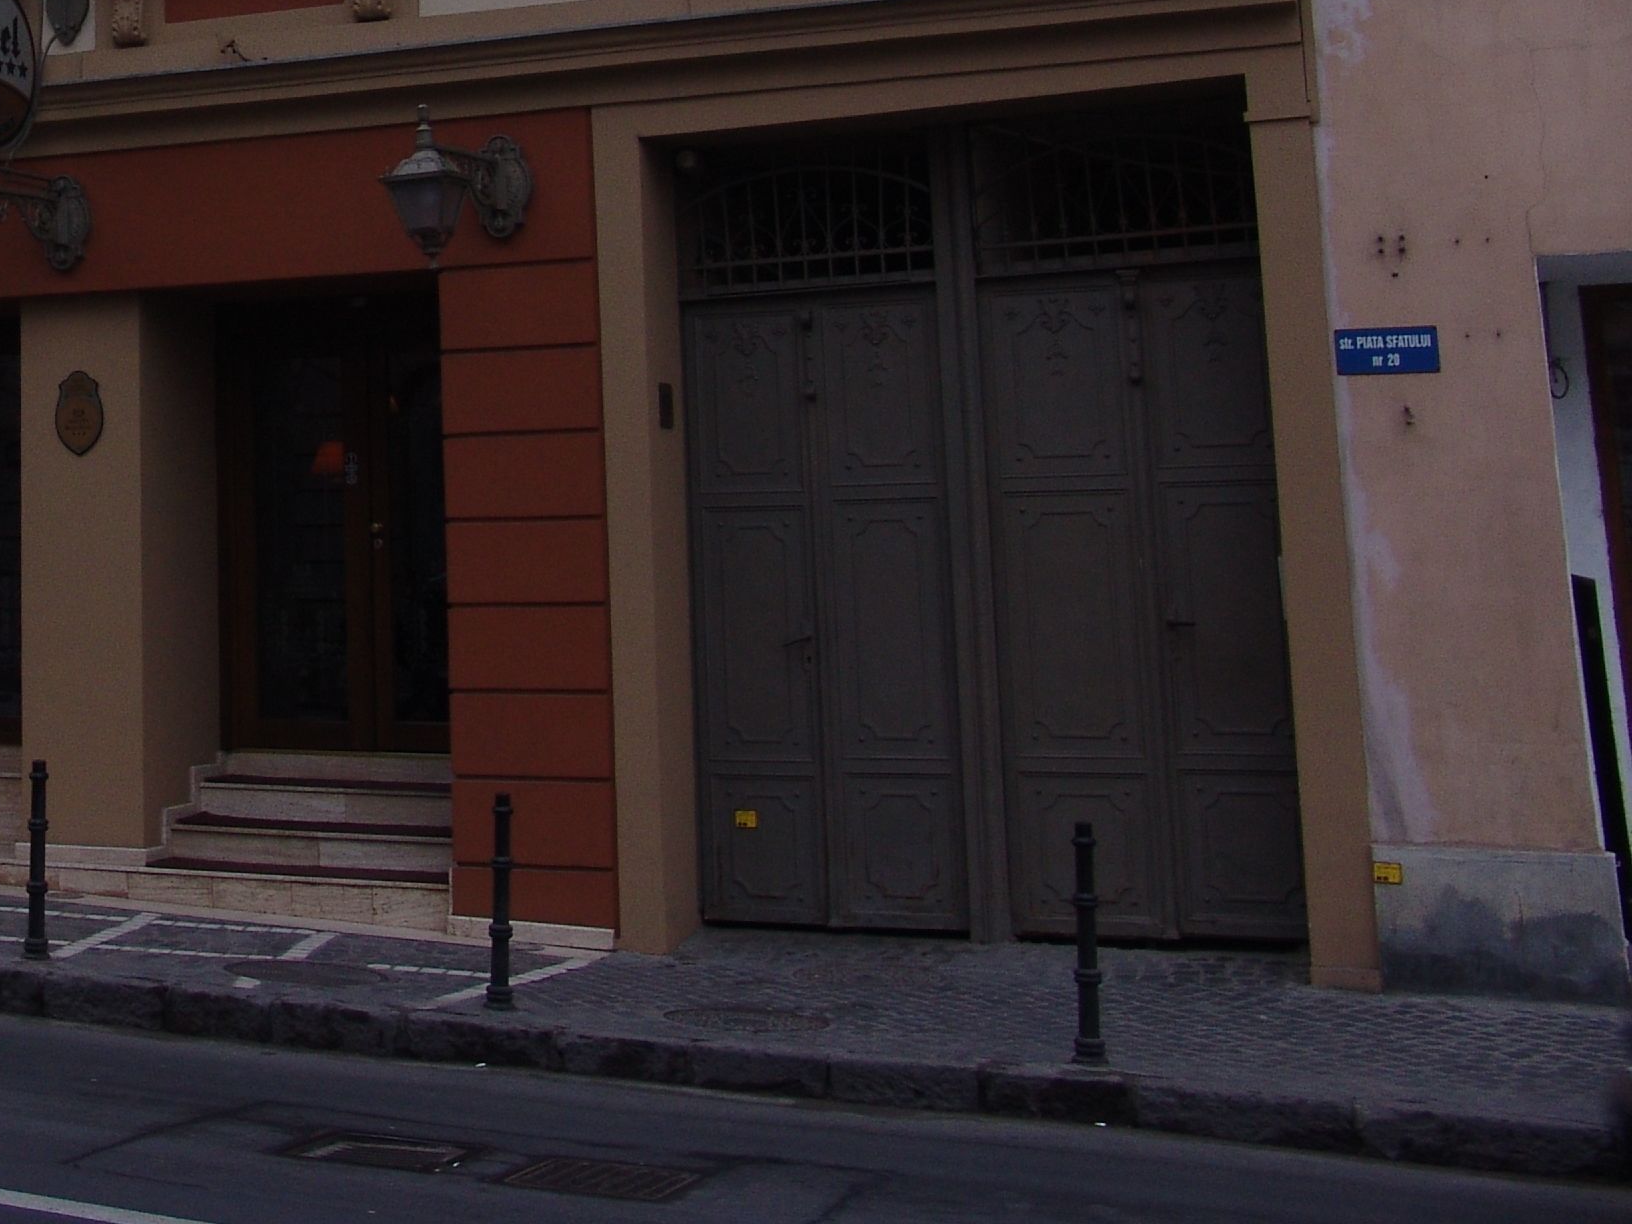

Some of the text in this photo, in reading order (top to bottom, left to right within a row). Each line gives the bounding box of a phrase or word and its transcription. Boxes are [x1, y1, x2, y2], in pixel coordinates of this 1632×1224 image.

[1339, 334, 1431, 350] str. PIATA SFATULUI
[1372, 353, 1400, 367] nr 20
